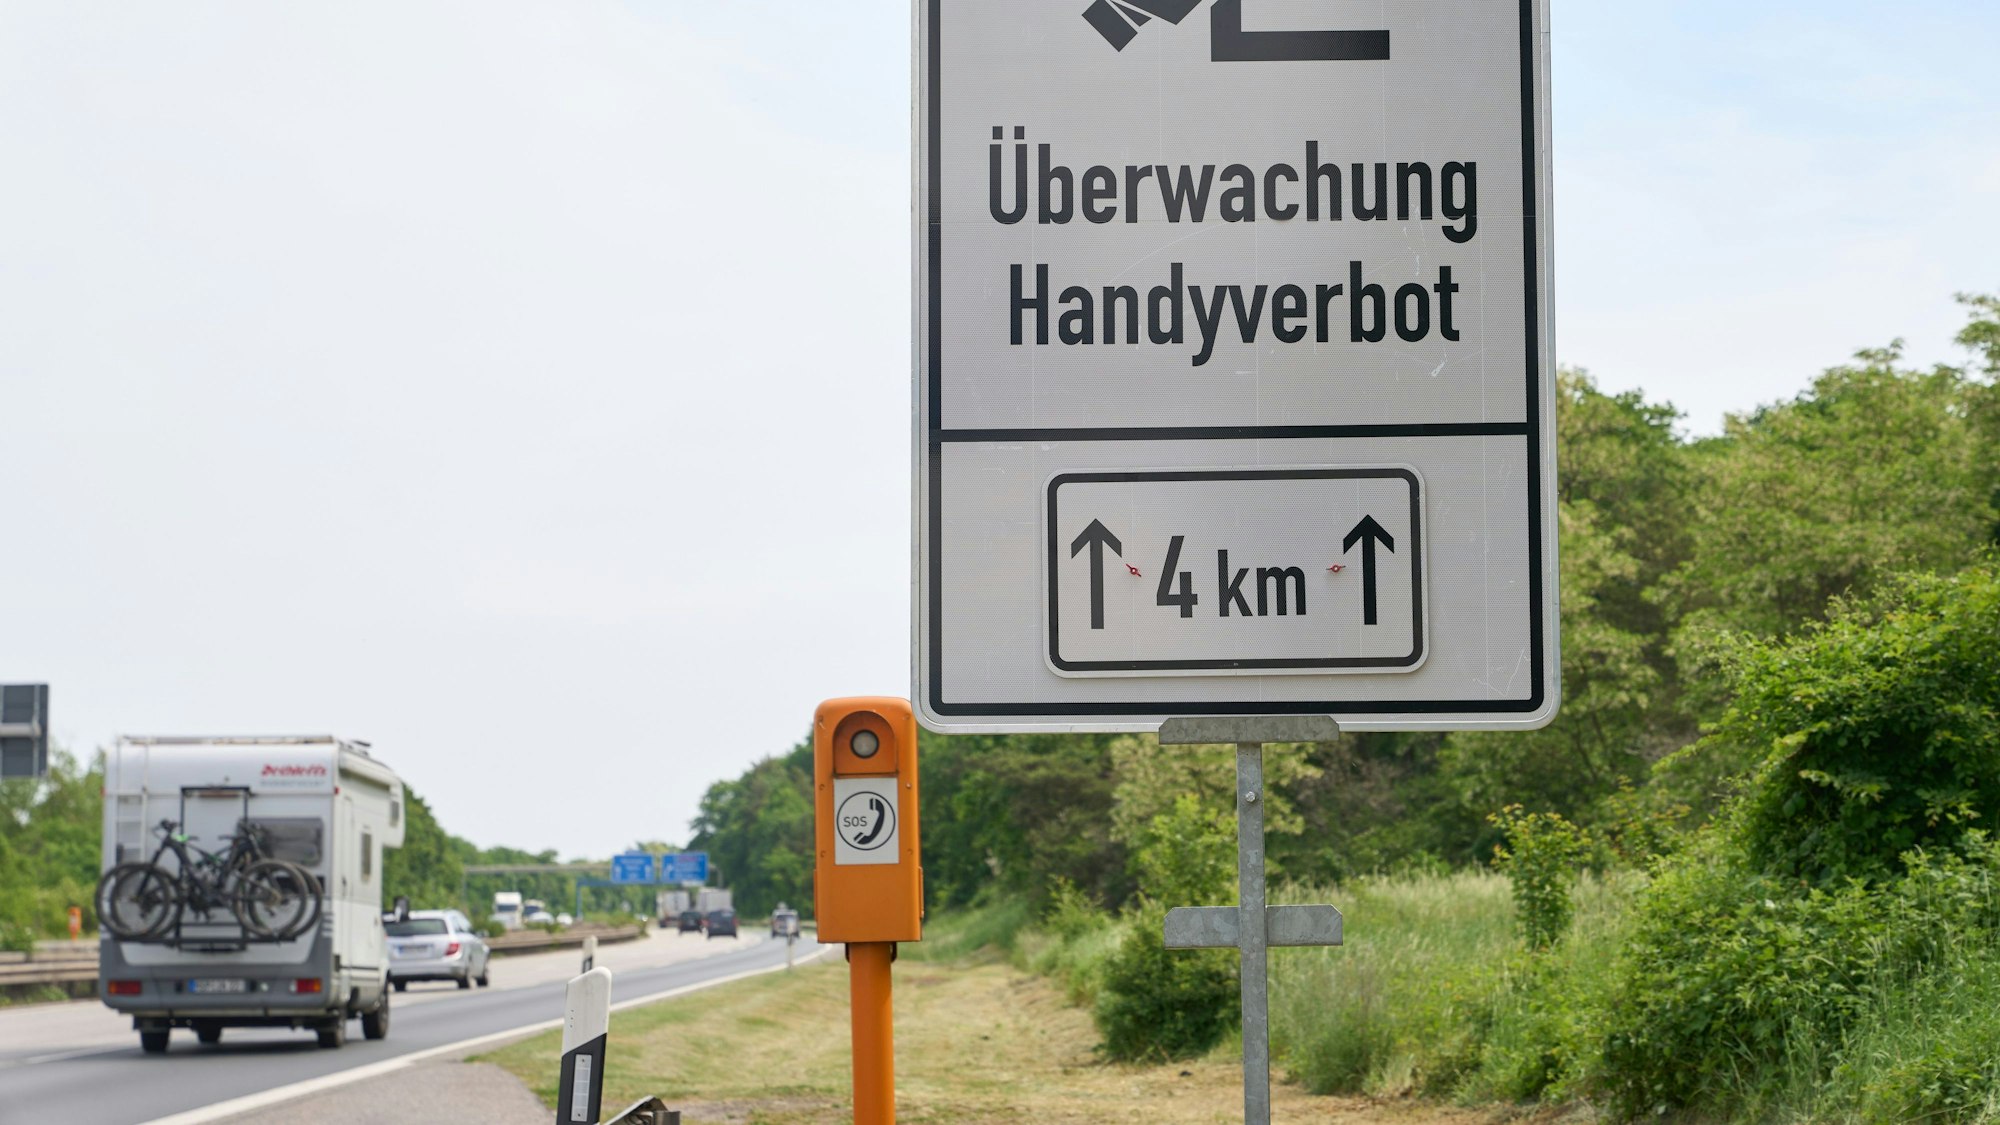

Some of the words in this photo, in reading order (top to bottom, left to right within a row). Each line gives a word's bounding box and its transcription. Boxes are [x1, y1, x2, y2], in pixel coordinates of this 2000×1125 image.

[989, 125, 1478, 244] Überwachung
[1009, 260, 1460, 367] Handyverbot
[1156, 535, 1199, 619] 4
[1217, 548, 1307, 618] km
[843, 816, 868, 828] SOS
